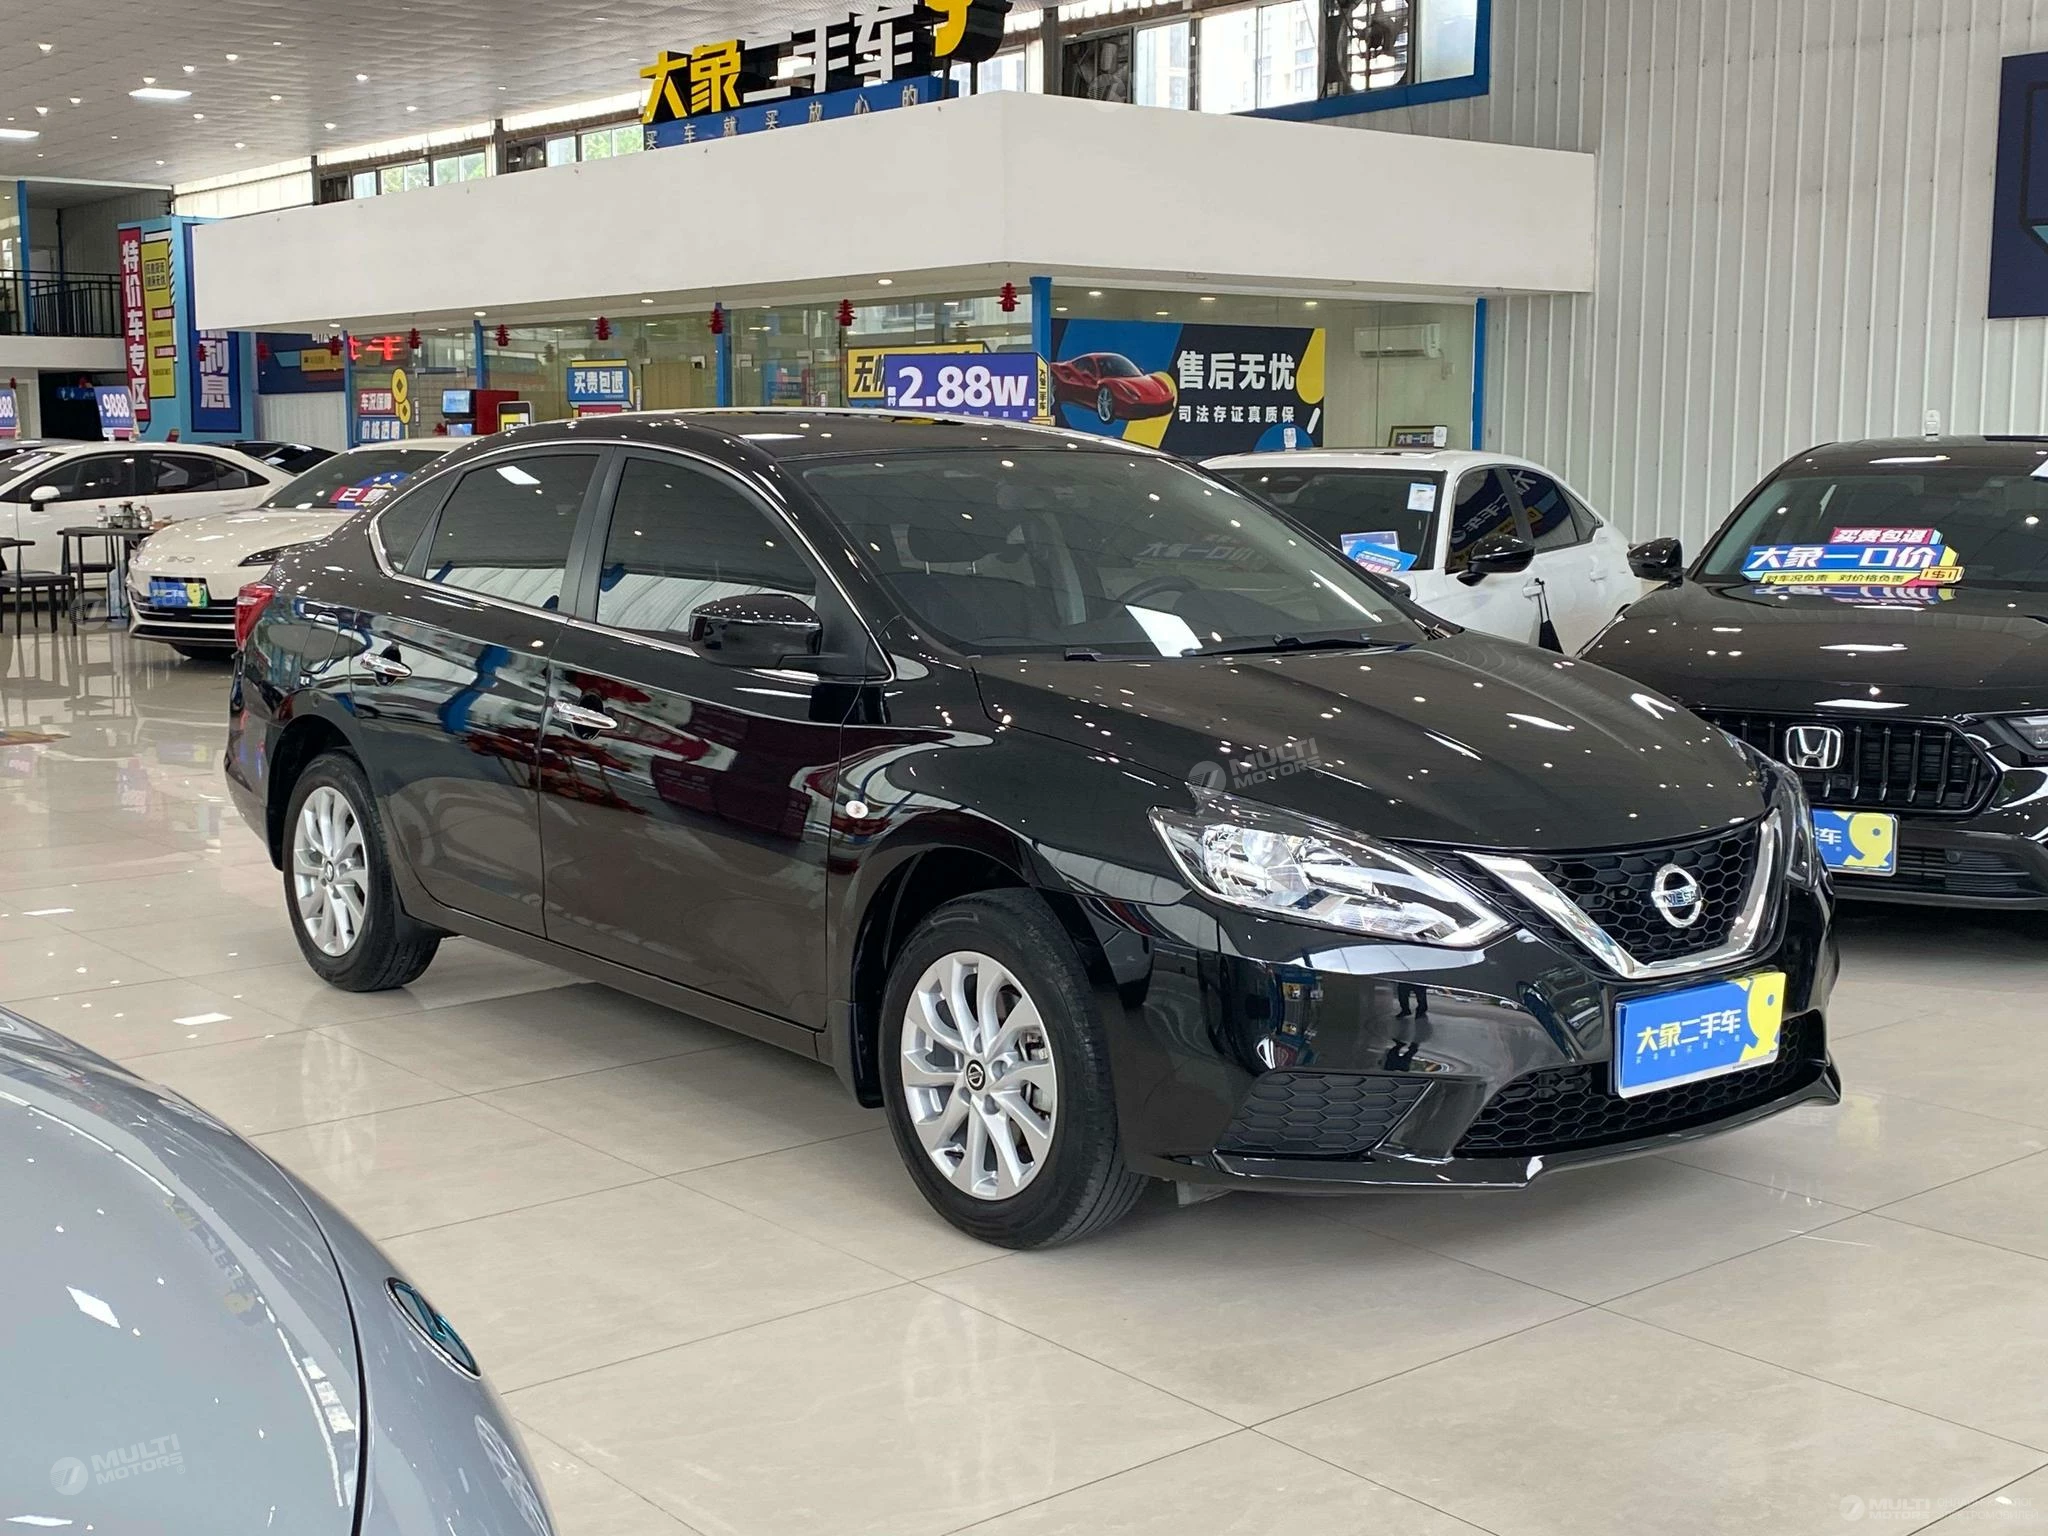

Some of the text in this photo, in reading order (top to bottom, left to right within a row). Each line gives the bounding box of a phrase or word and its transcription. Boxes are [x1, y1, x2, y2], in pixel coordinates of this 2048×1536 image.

[639, 2, 916, 125] 大象二手车
[122, 240, 148, 411] 特价车专区
[199, 330, 231, 408] 利息
[574, 370, 624, 394] 买贵包退
[1176, 349, 1297, 391] 售后无忧
[102, 394, 130, 418] 9888
[1178, 405, 1295, 423] 司法存证真质保
[1832, 529, 1926, 544] 买贵包退
[1747, 547, 1936, 568] 大象一口价
[1636, 1009, 1742, 1055] 大象二手车
